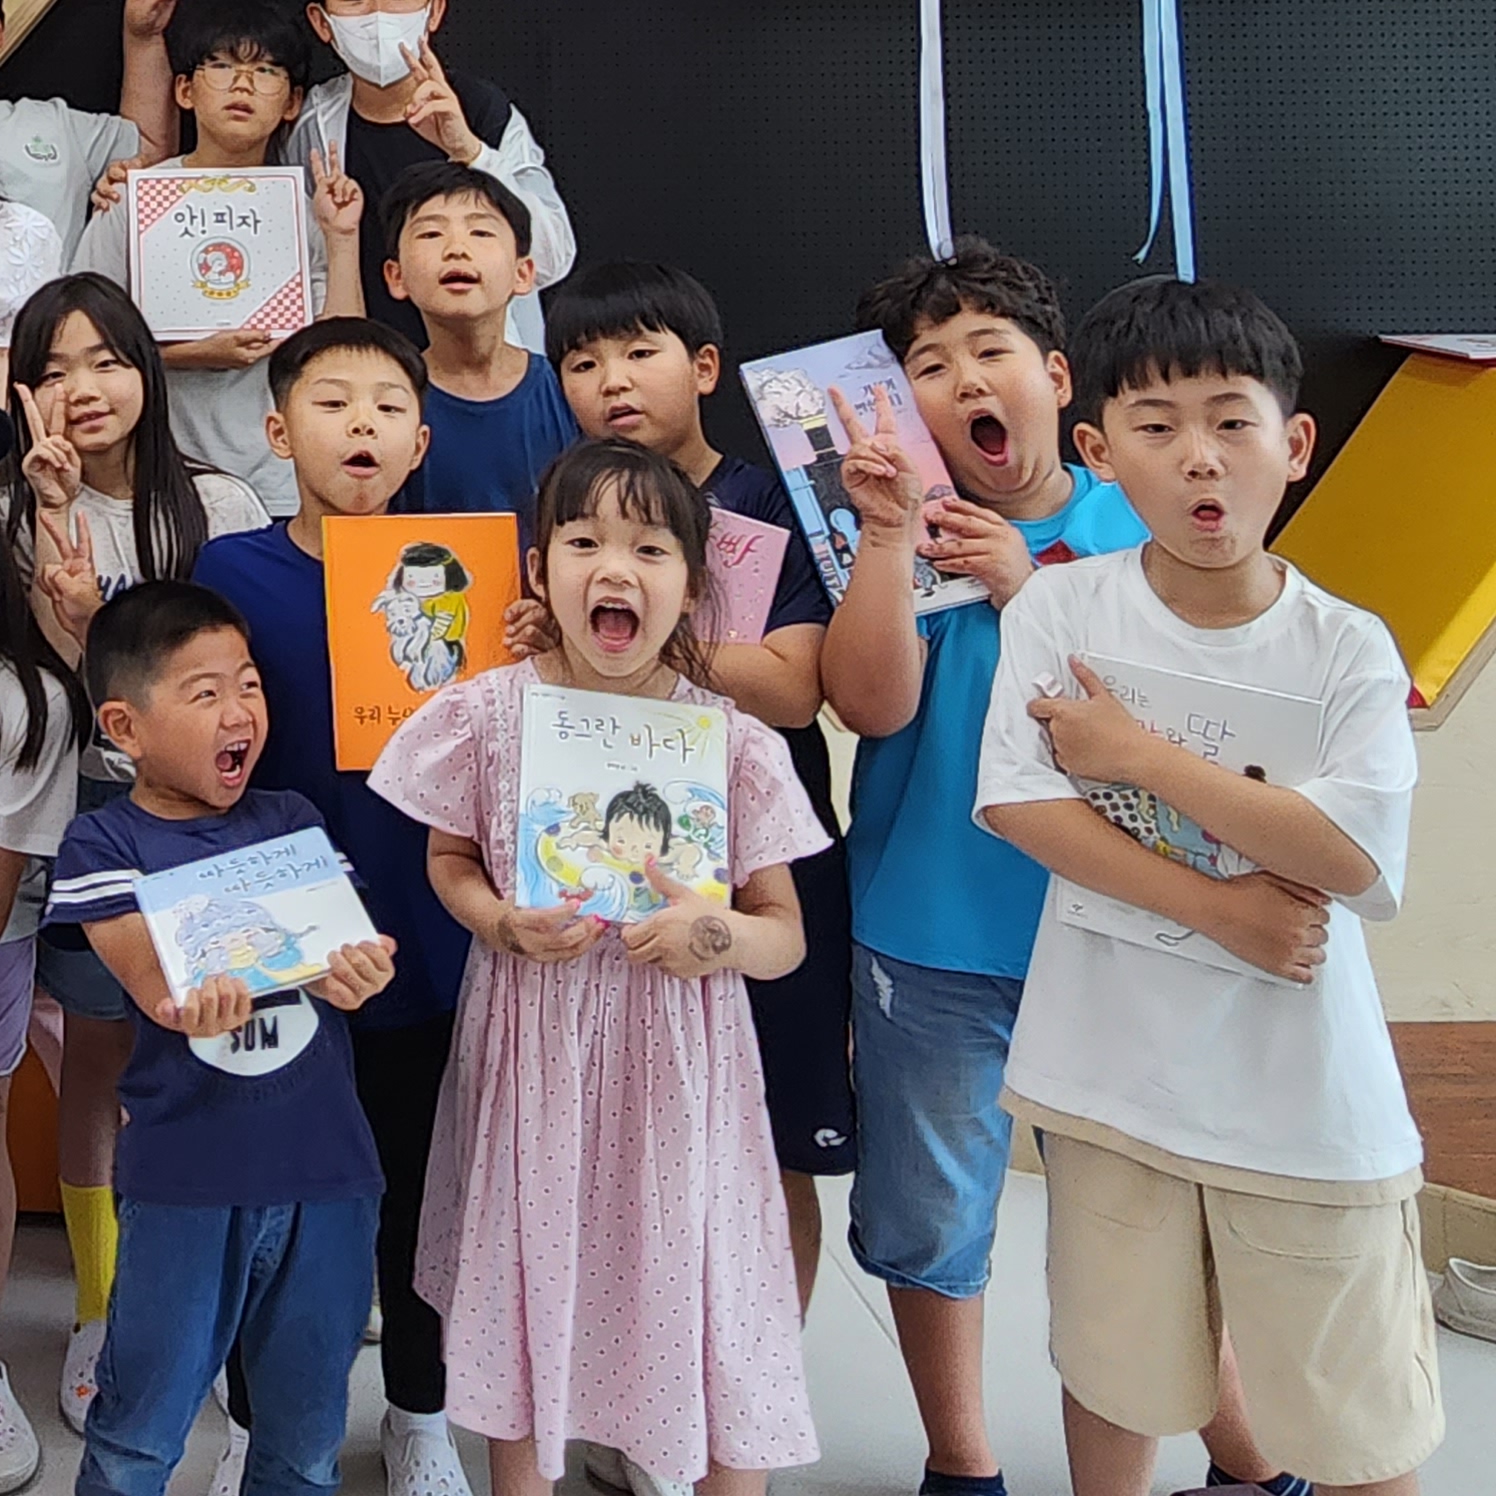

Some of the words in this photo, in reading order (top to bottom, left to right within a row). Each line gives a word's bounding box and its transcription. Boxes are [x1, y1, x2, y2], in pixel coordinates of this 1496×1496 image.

[353, 705, 382, 725] 우리
[551, 709, 622, 750] 동그란
[629, 724, 695, 764] 바다
